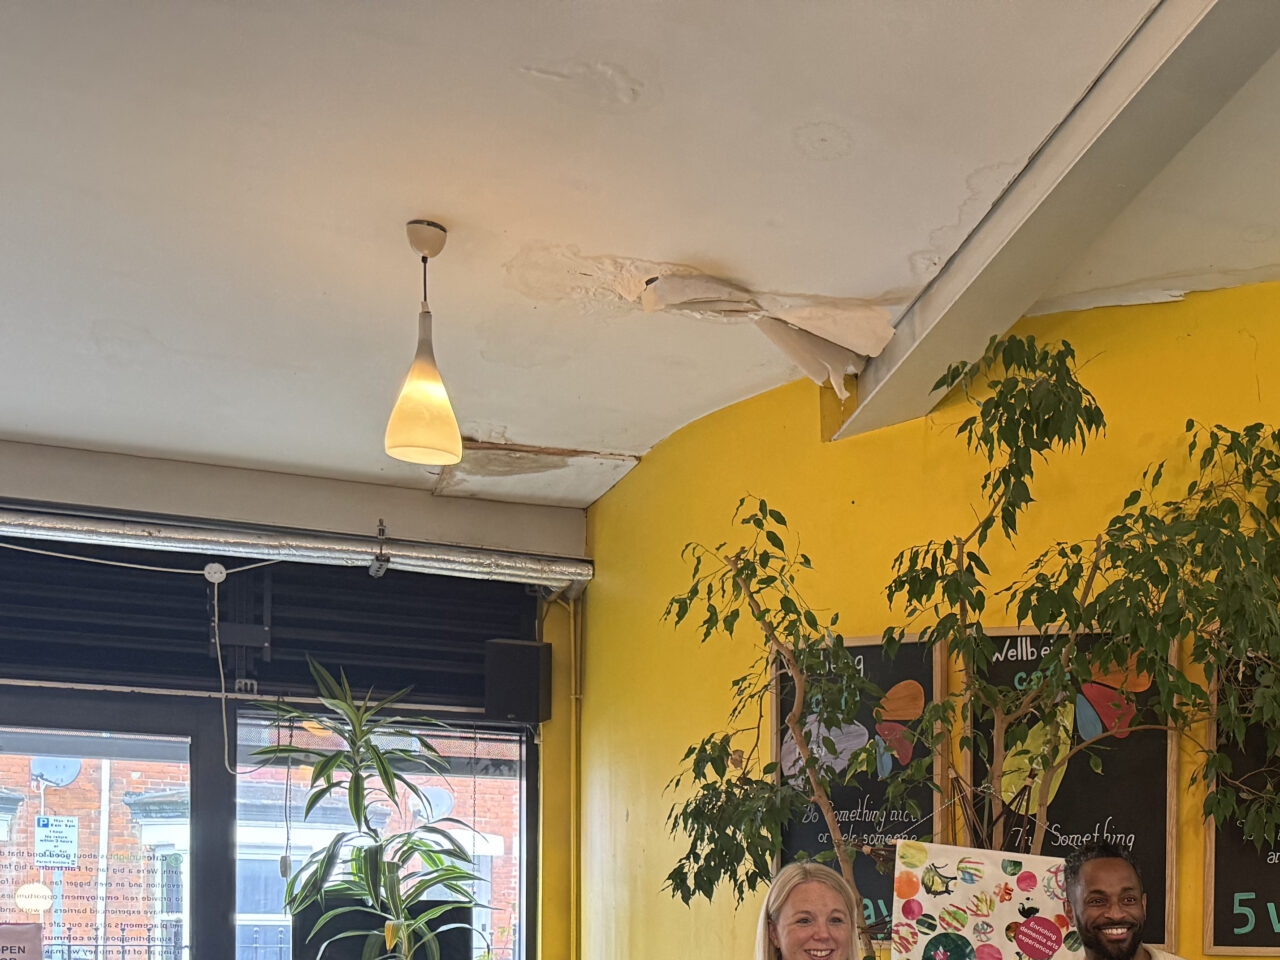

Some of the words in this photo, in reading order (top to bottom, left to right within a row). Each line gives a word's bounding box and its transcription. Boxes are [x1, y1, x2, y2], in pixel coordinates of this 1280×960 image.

[992, 637, 1077, 662] Wellbe
[829, 795, 886, 830] omething
[818, 833, 830, 843] or
[1051, 817, 1135, 851] Something
[1233, 892, 1256, 934] 5
[1020, 926, 1046, 943] dementia
[1047, 941, 1059, 950] arts
[1030, 921, 1056, 940] Enriching
[1019, 935, 1052, 955] experiences
